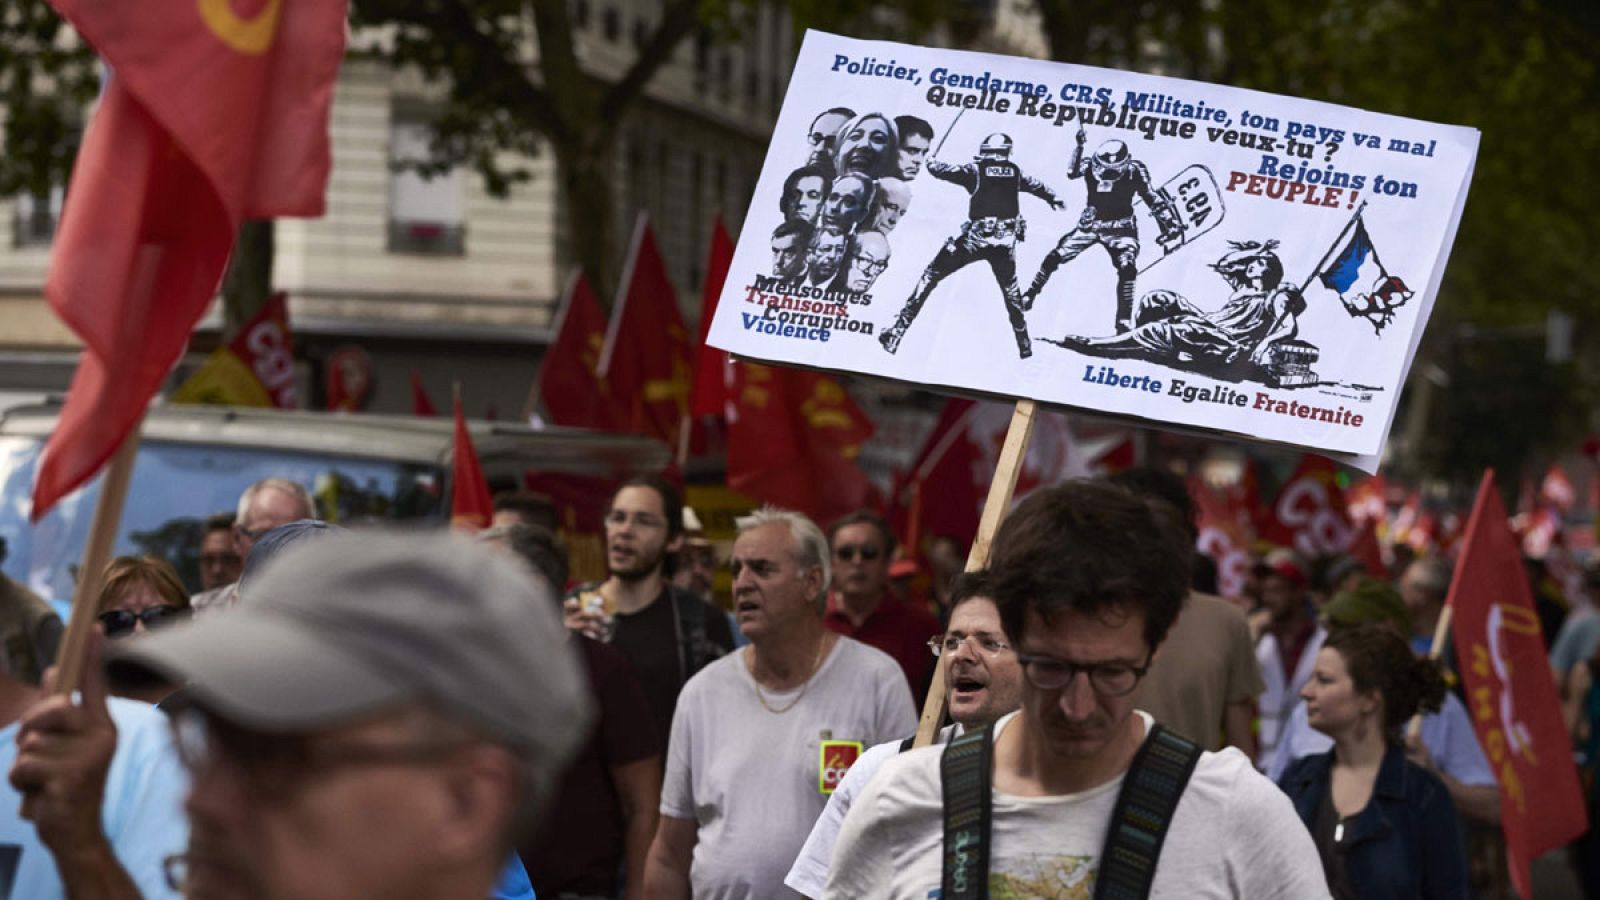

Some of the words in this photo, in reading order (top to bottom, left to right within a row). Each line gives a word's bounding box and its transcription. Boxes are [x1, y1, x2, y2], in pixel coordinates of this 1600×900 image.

[831, 54, 922, 86] Policier,
[929, 67, 1053, 102] Gendarme,
[1060, 83, 1116, 112] CRS,
[1125, 91, 1233, 128] Militaire,
[1240, 110, 1280, 133] ton
[1284, 121, 1346, 146] pays
[1353, 132, 1382, 150] va
[1387, 140, 1438, 157] mal
[925, 85, 1011, 113] Quelle
[1016, 94, 1197, 141] Republique
[1207, 126, 1315, 160] veux-tu
[1323, 142, 1340, 162] ?
[1225, 171, 1344, 209] PEUPLE
[1346, 190, 1360, 210] !
[1257, 155, 1367, 190] Rejoins
[1372, 174, 1418, 199] ton
[745, 284, 849, 318] Trahisons
[755, 274, 873, 306] Mensonges
[741, 312, 831, 342] Violence
[763, 306, 875, 336] Corruption
[1082, 365, 1163, 393] Liberte
[1167, 378, 1249, 408] Egalite
[1252, 392, 1364, 428] Fraternite
